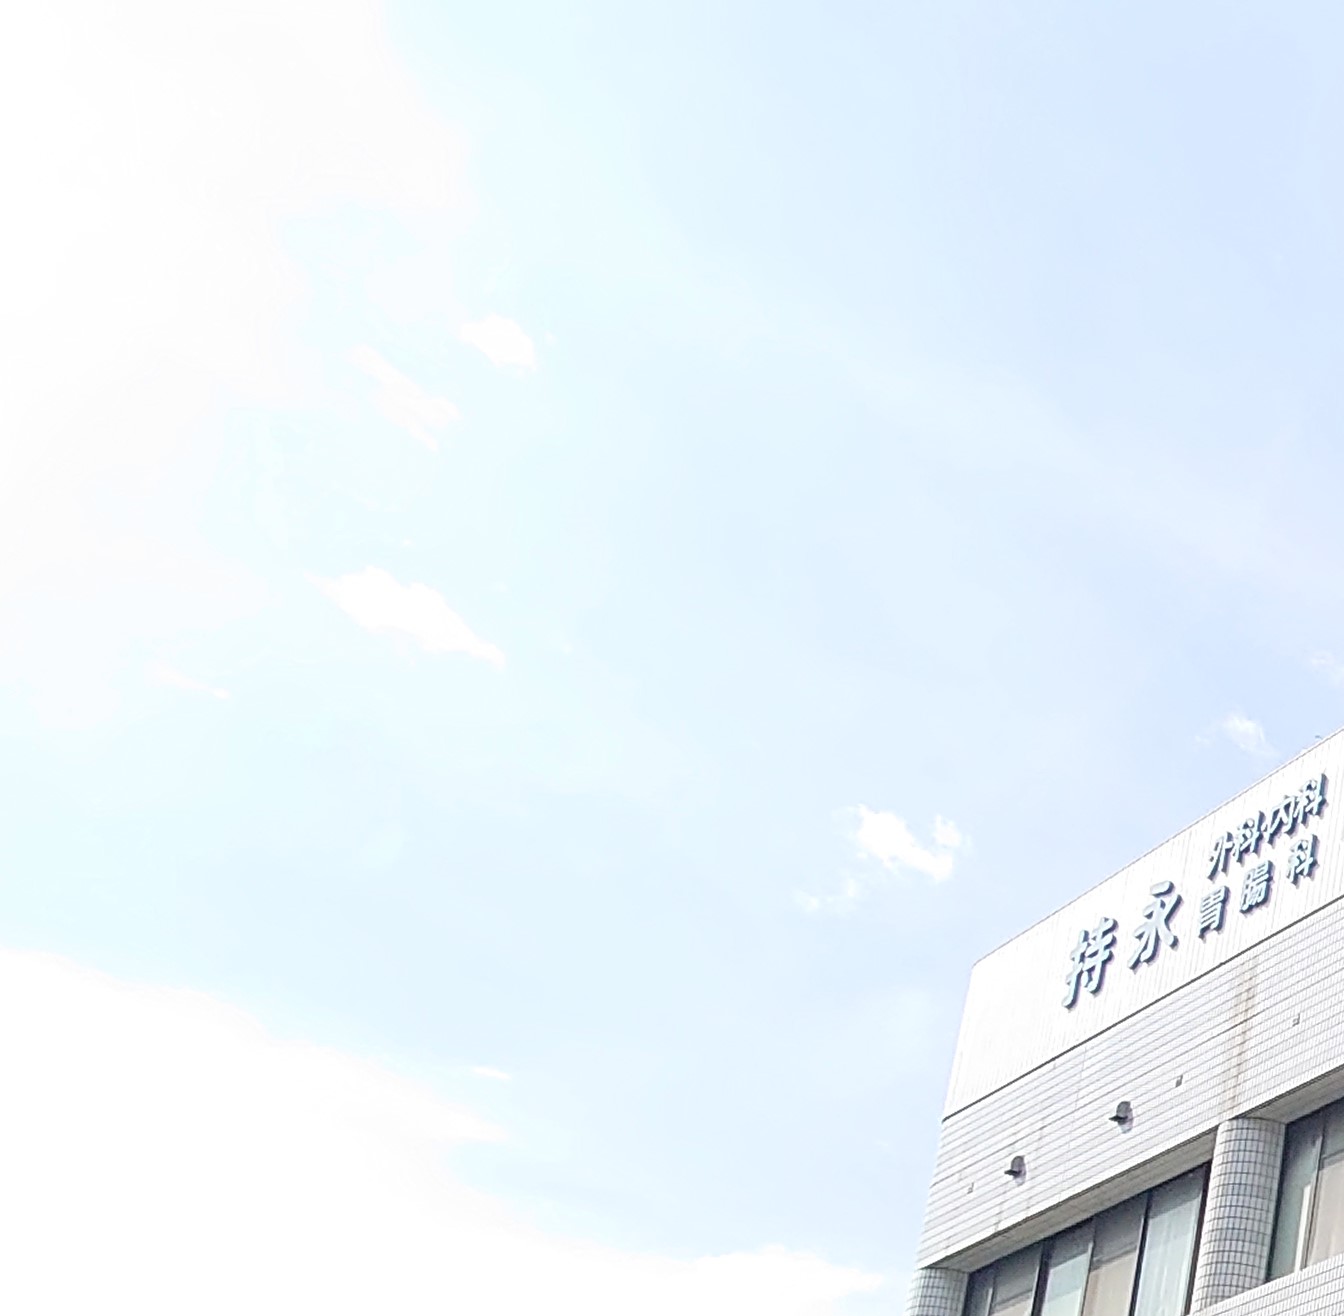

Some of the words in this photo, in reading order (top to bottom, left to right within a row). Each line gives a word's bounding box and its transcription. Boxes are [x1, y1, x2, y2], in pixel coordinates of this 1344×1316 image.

[1062, 880, 1184, 1009] 持永
[1199, 834, 1320, 940] 胃腸科
